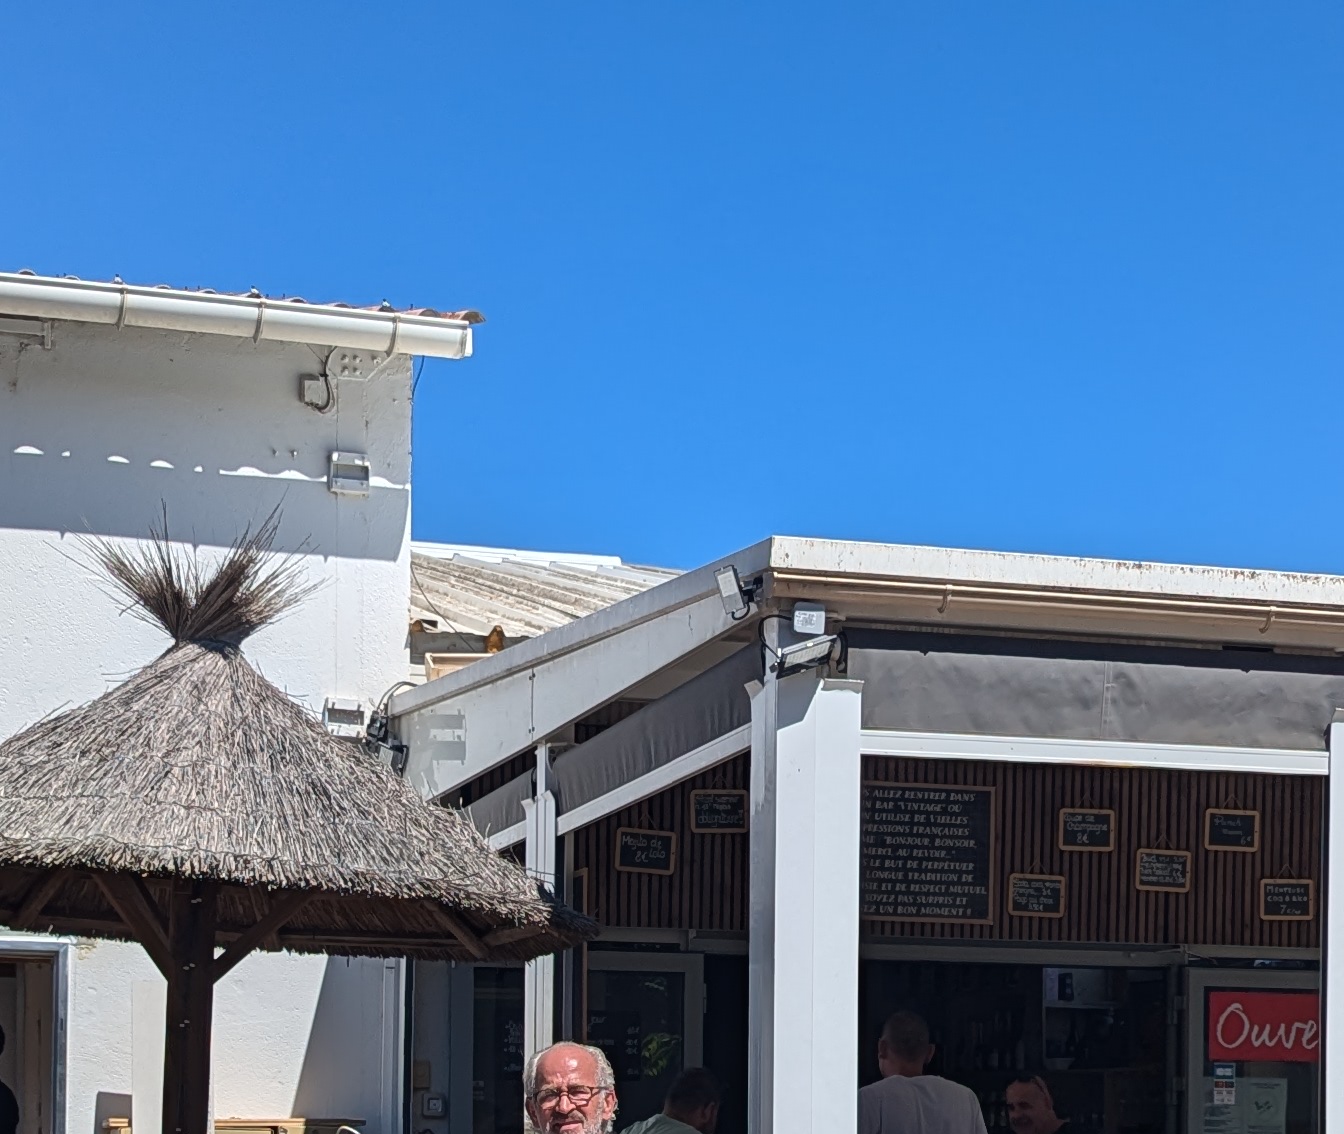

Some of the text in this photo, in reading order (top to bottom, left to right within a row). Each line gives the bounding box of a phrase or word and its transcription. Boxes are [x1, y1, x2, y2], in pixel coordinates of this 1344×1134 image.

[872, 789, 902, 799] ALLEZ
[905, 790, 947, 800] RENTRER
[950, 792, 976, 802] DANS
[875, 801, 895, 809] BAR
[874, 812, 911, 822] UTILISE
[914, 814, 927, 823] DE
[913, 825, 970, 836] FRANÇAISES
[934, 838, 977, 849] BONSOIR,
[896, 848, 910, 857] AU
[869, 859, 881, 868] LE
[884, 859, 904, 868] BUT
[906, 860, 920, 869] DE
[865, 870, 974, 883] LONGUE TRADITION DE
[881, 882, 893, 891] ET
[895, 883, 907, 892] DE
[909, 883, 947, 893] RESPECT
[948, 885, 988, 895] MUTUEL
[864, 894, 969, 905] SOYEZ PAS SURPRIS ET
[879, 905, 894, 914] UN
[897, 905, 918, 914] BON
[920, 906, 965, 916] MOMENT
[1216, 1003, 1319, 1049] Ouve
